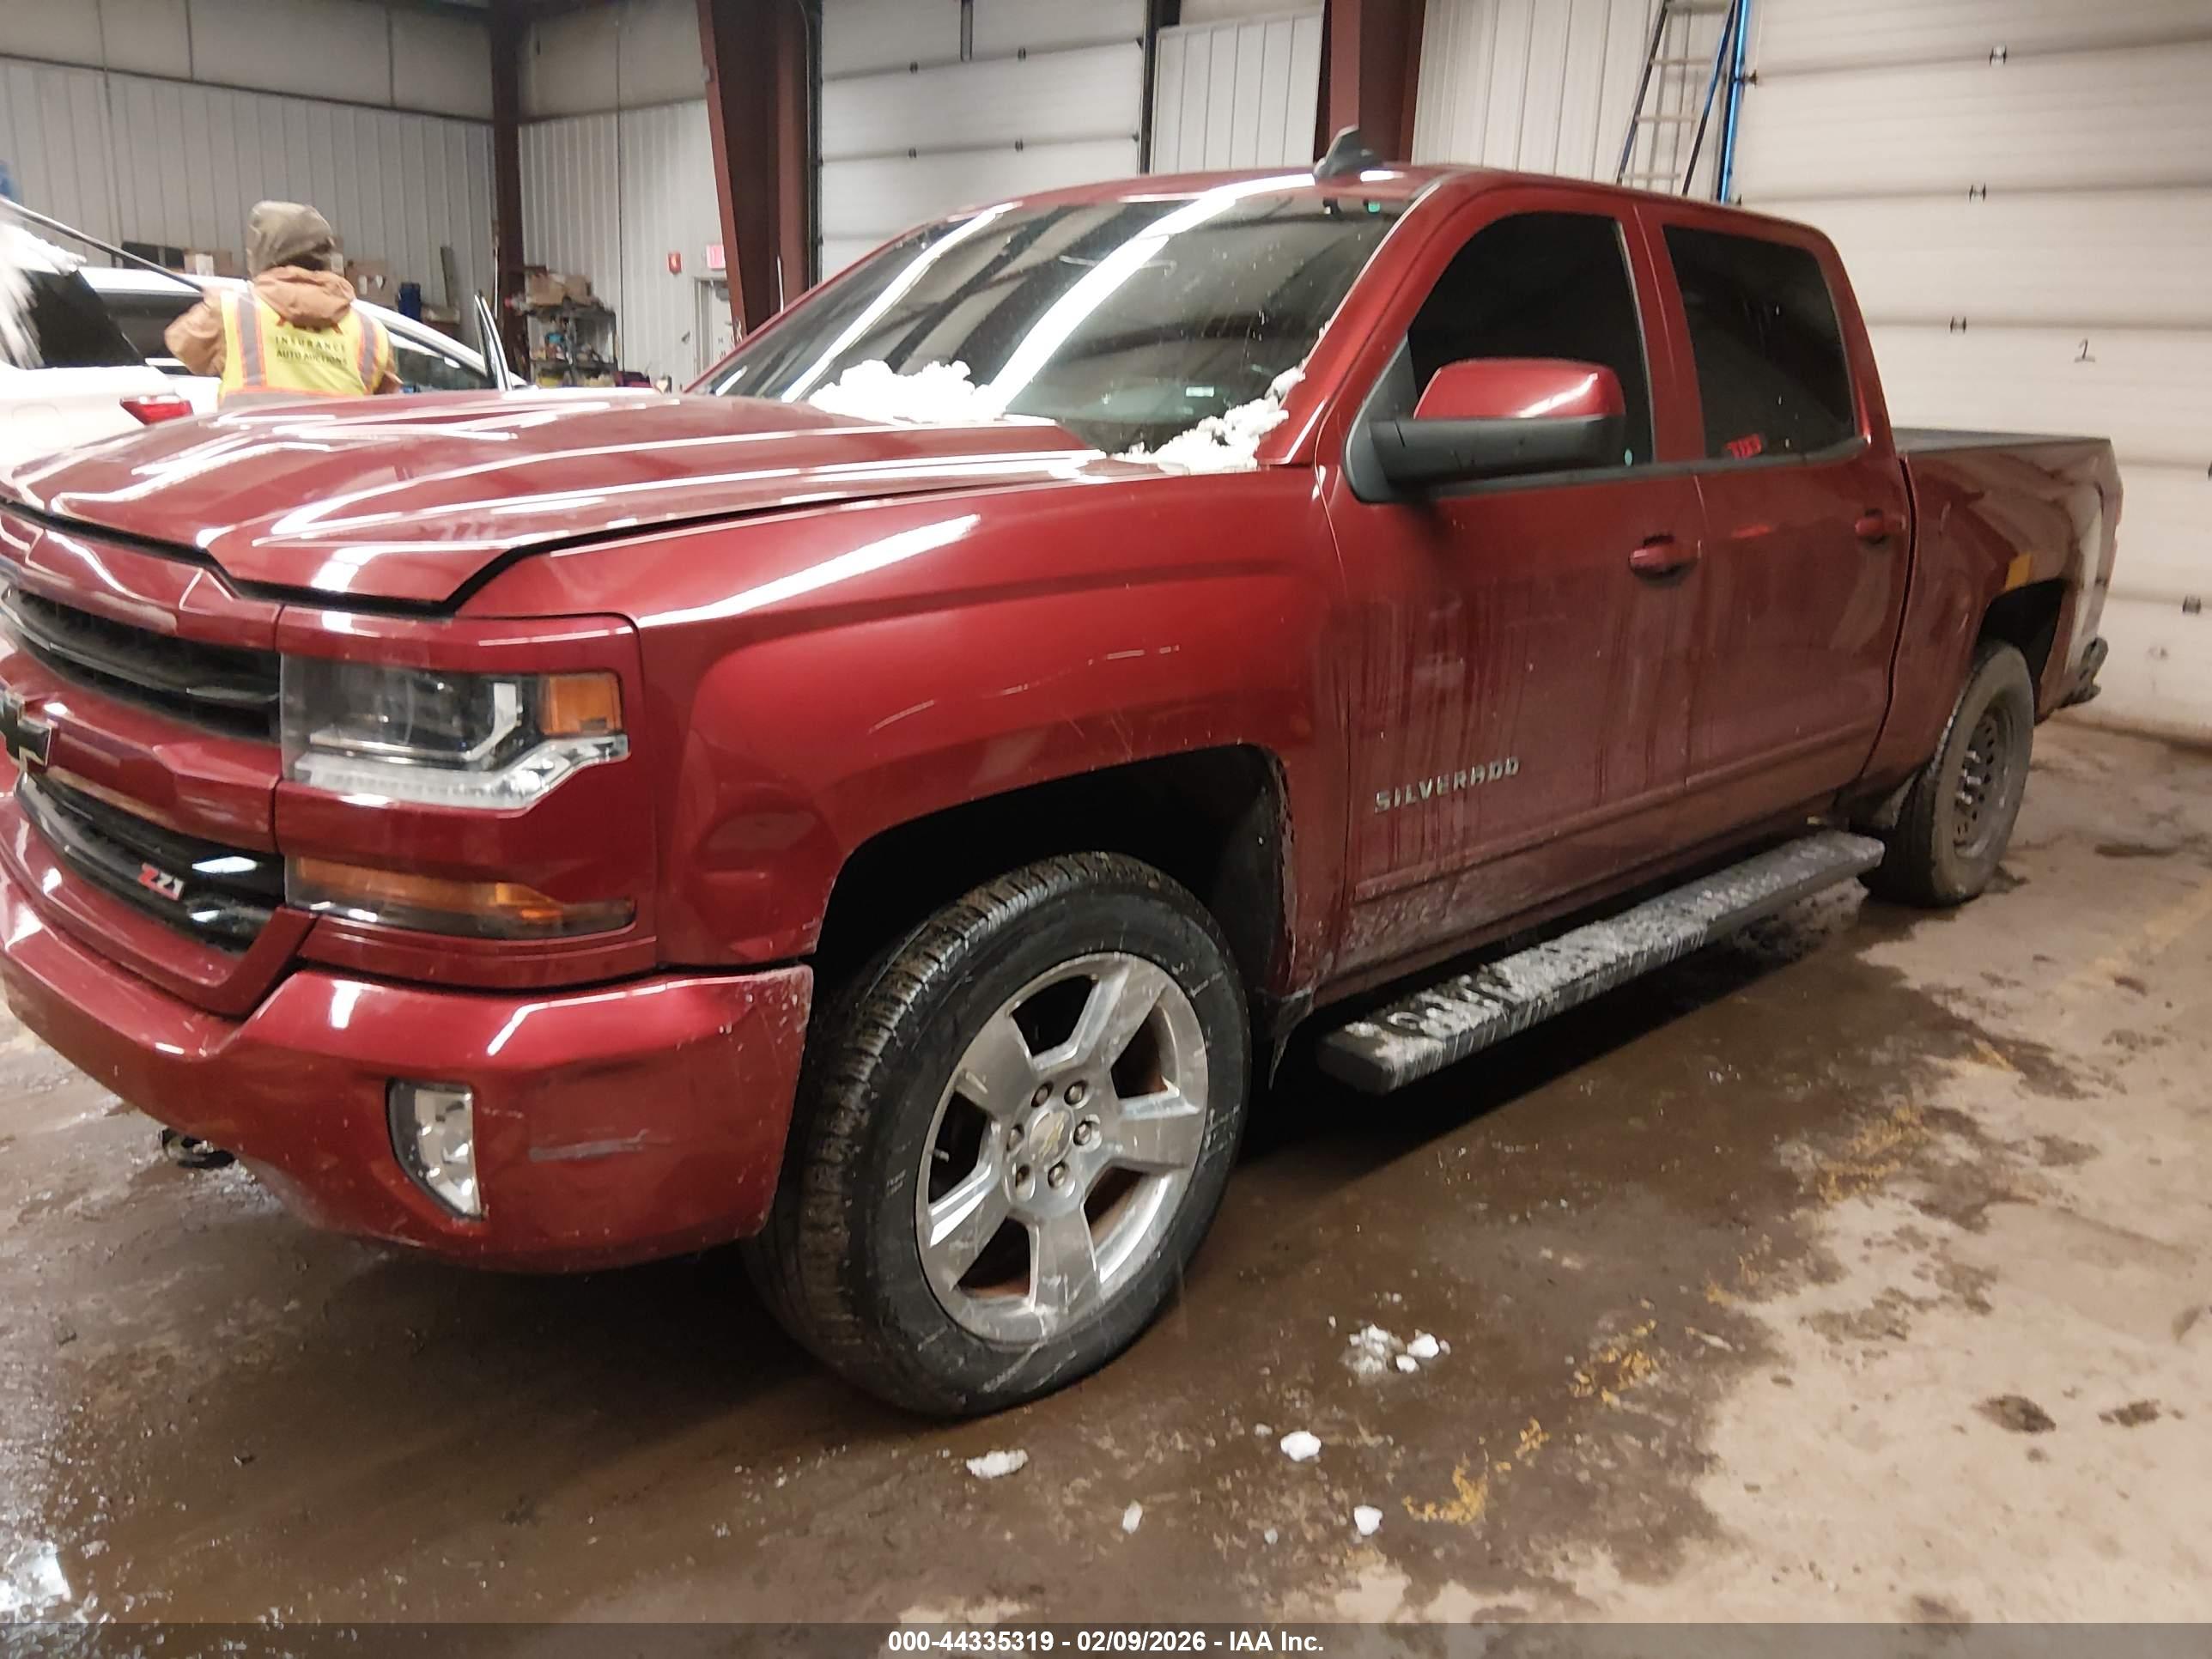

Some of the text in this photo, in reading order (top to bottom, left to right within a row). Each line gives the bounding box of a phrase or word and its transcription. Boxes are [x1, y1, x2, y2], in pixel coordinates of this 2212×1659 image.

[275, 336, 345, 351] INSURANCE
[276, 349, 348, 365] AUTO AUCTIONS
[1374, 756, 1520, 813] SILVERADO
